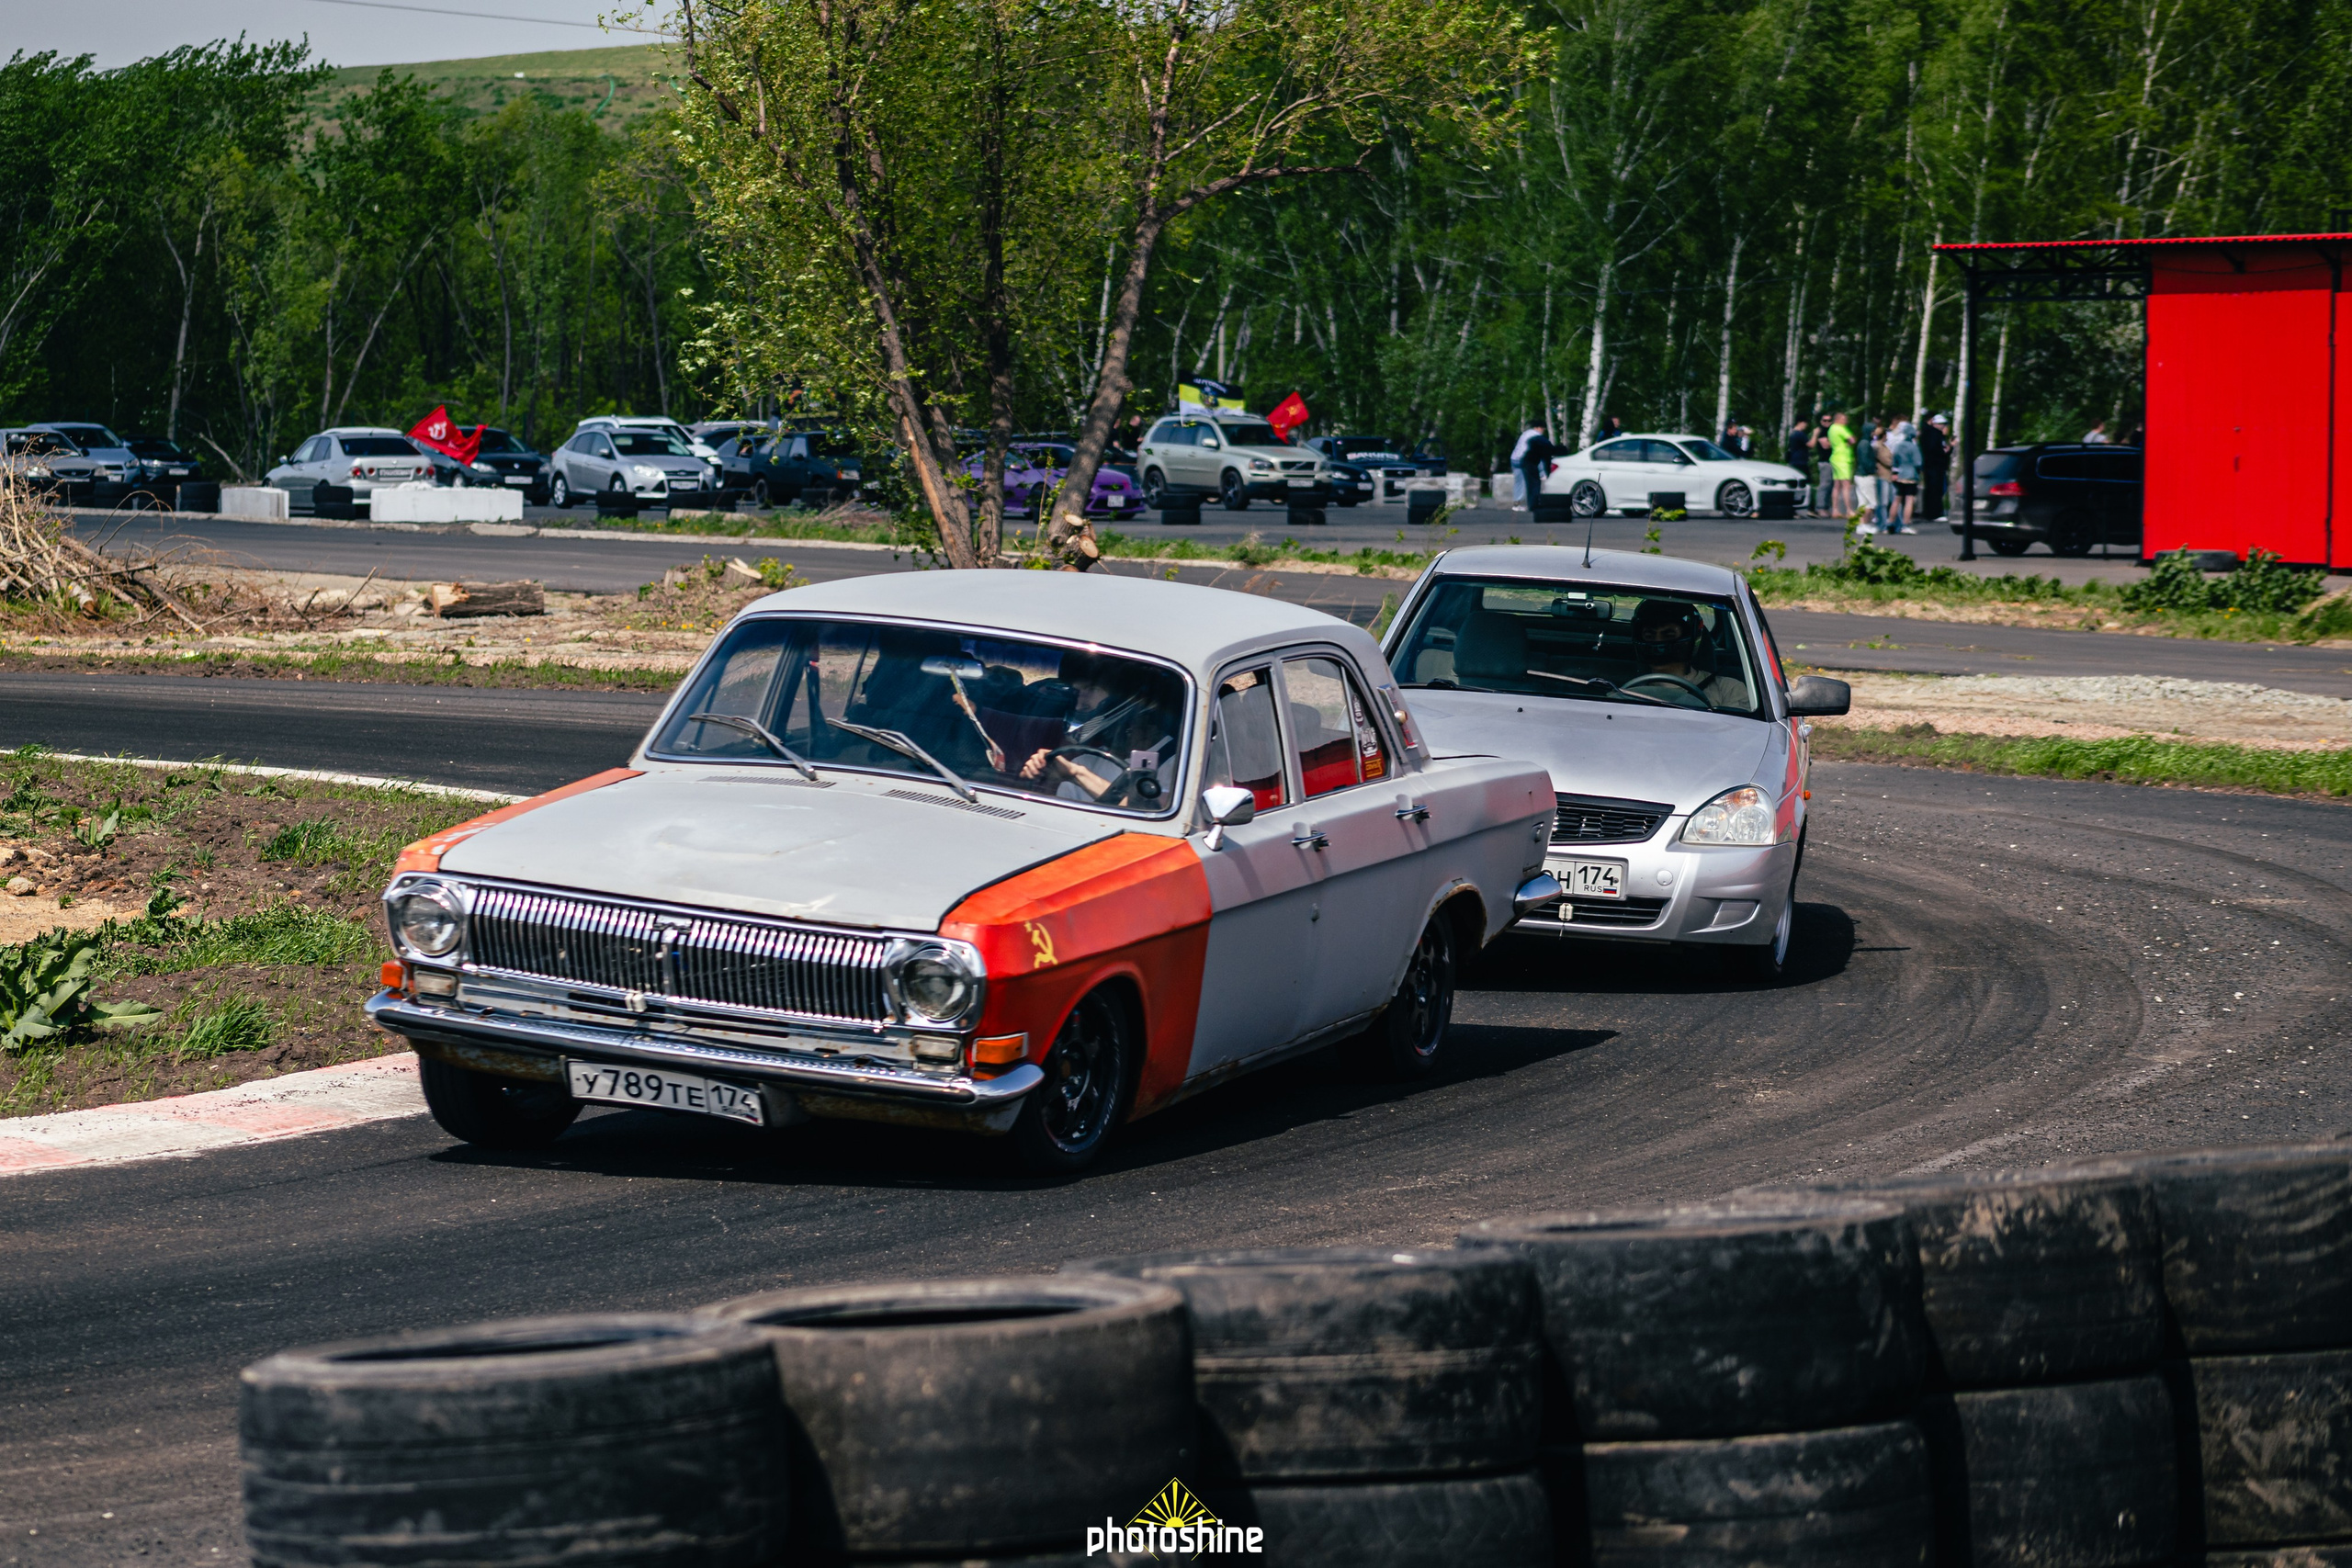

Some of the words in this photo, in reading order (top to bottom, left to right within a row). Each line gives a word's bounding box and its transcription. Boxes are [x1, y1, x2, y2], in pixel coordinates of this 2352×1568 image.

[1577, 865, 1615, 886] 174
[1583, 885, 1603, 893] RUS
[711, 1085, 757, 1112] 174
